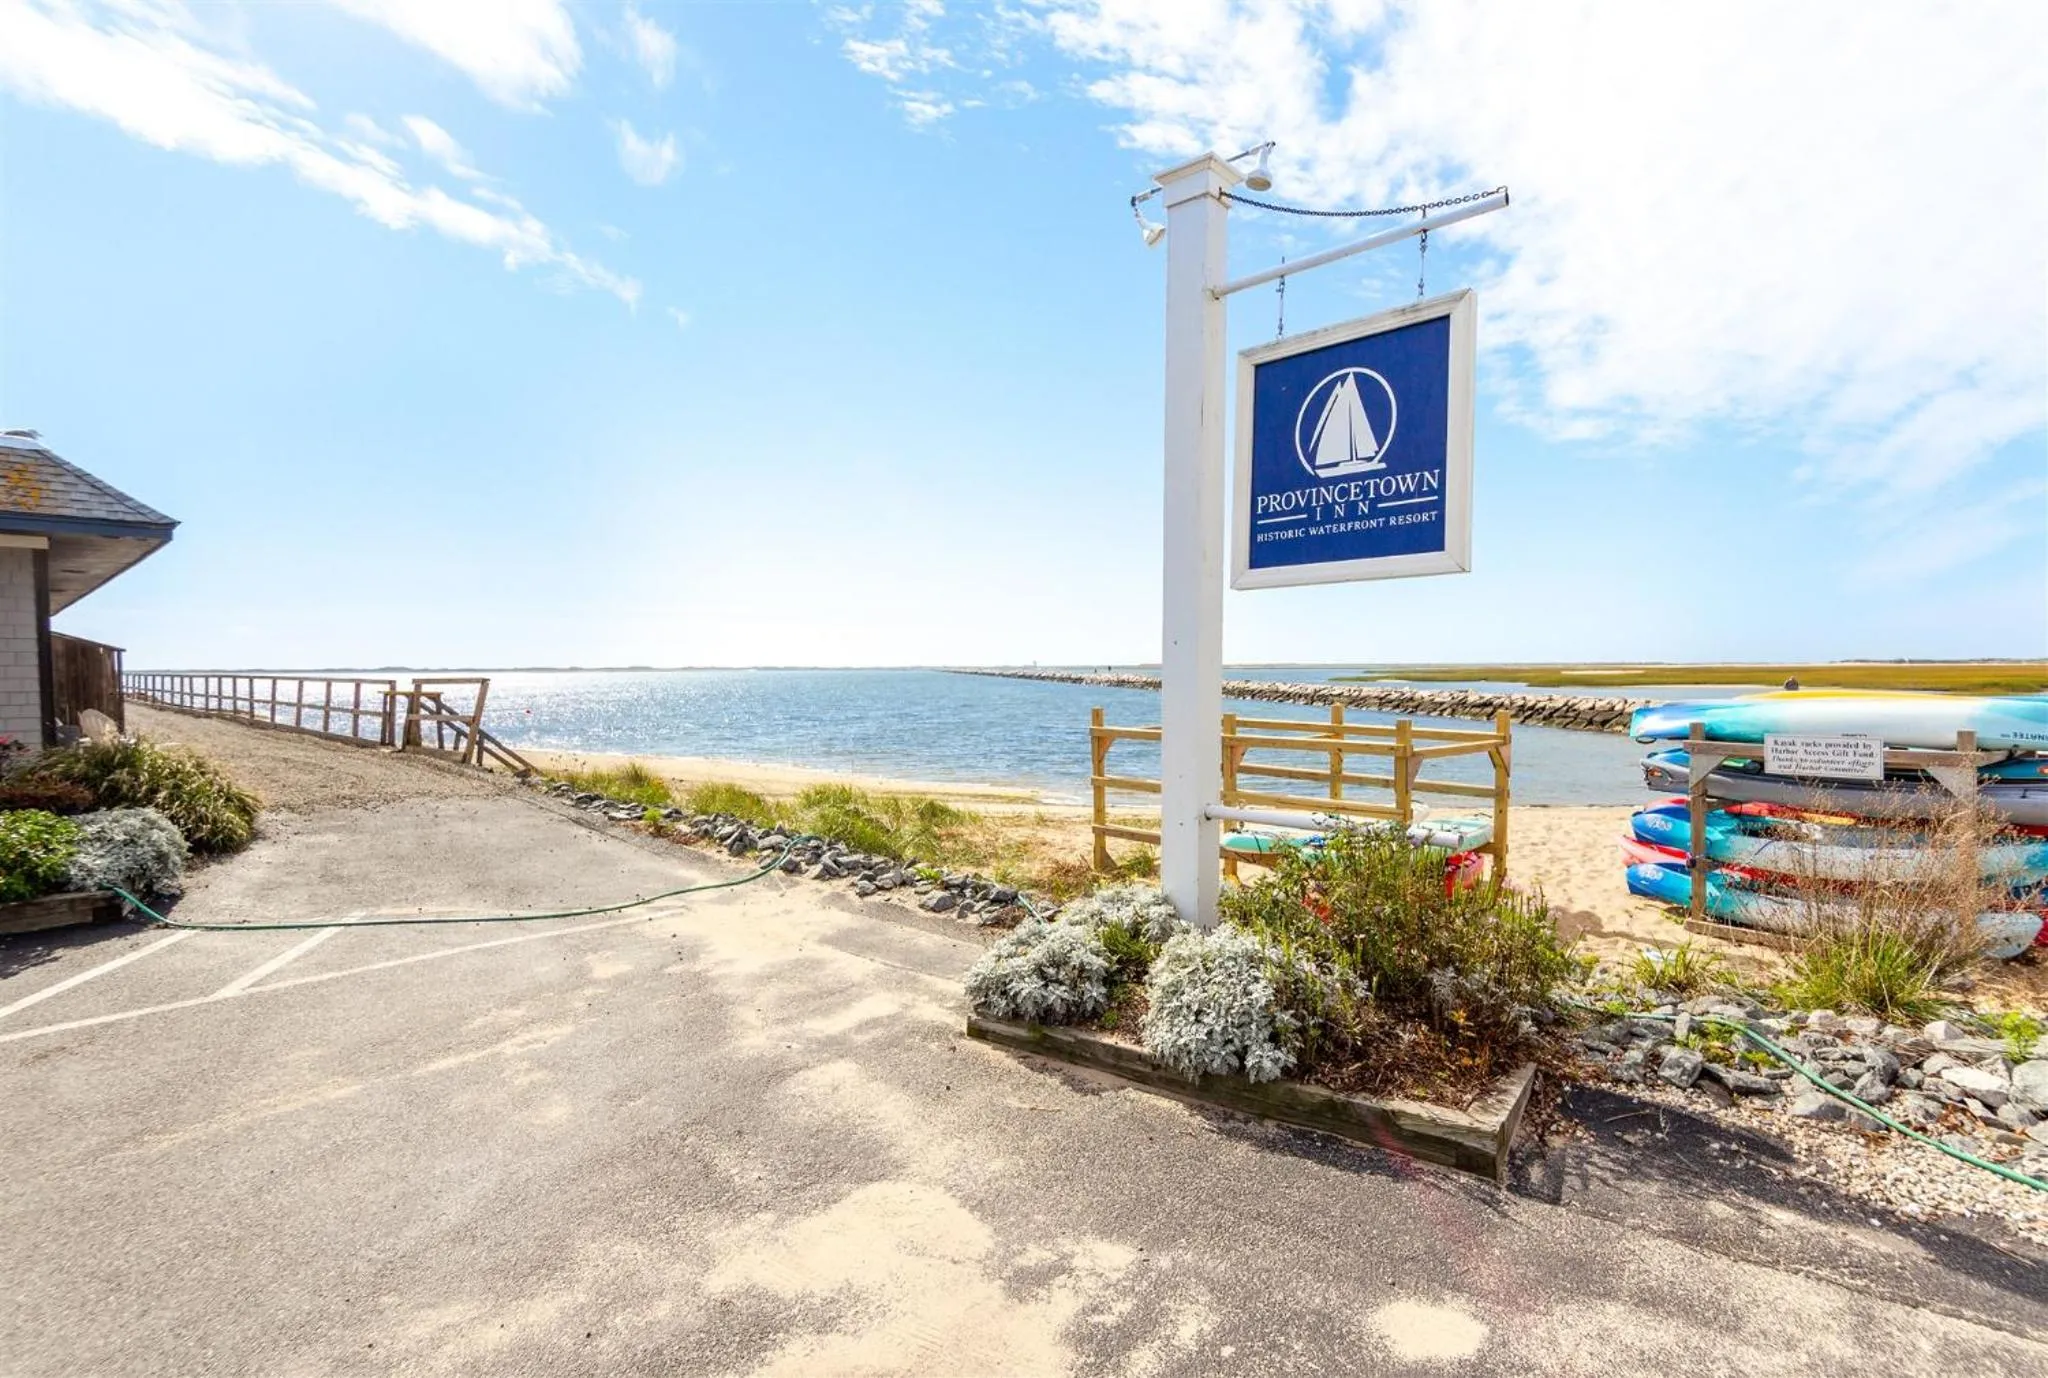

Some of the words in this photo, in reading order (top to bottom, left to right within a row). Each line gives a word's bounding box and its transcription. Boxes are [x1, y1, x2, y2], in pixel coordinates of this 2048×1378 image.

[1256, 469, 1440, 515] PROVINCETOWN
[1316, 501, 1370, 521] INN
[1256, 527, 1306, 543] HISTORIC
[1309, 517, 1386, 539] WATERFRONT
[1389, 511, 1439, 526] RESORT
[1771, 747, 1799, 755] Harbor
[1804, 749, 1829, 757] Access
[1853, 751, 1875, 759] Fund
[1773, 739, 1796, 747] Kayak
[1824, 741, 1859, 750] provided
[1862, 742, 1873, 750] by
